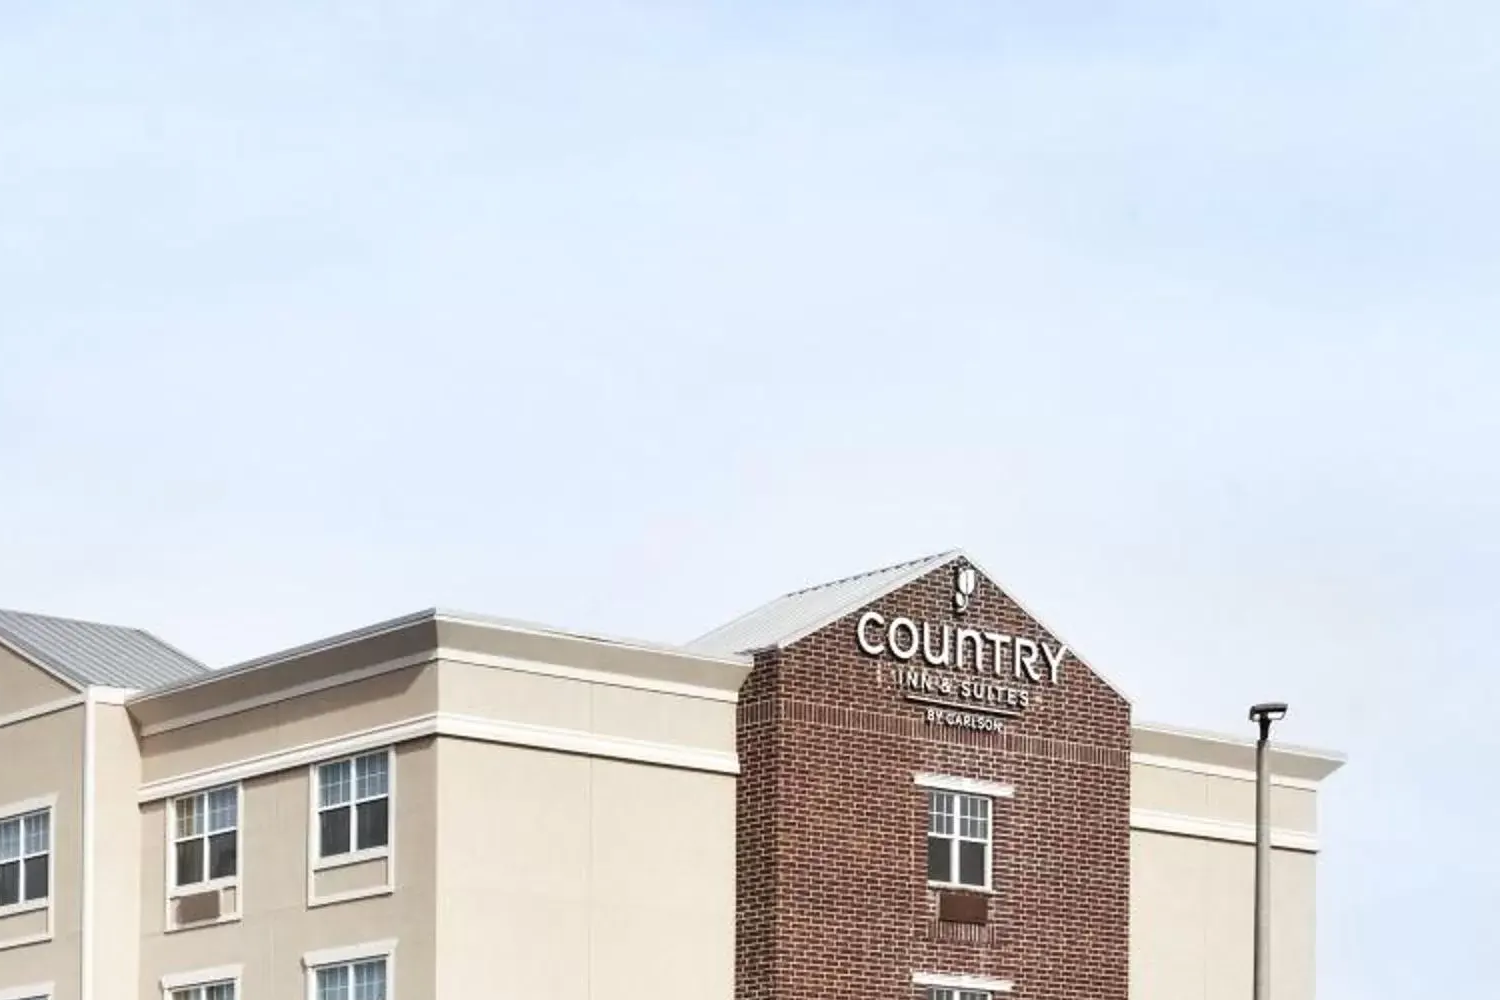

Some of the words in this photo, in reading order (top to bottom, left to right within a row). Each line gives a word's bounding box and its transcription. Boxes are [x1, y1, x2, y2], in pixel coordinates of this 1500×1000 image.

[857, 611, 1068, 684] COUNTRY
[898, 669, 932, 691] INN
[941, 677, 951, 693] &
[961, 681, 1030, 707] SUITES
[927, 709, 943, 725] BY
[947, 714, 1004, 732] CARLSON
